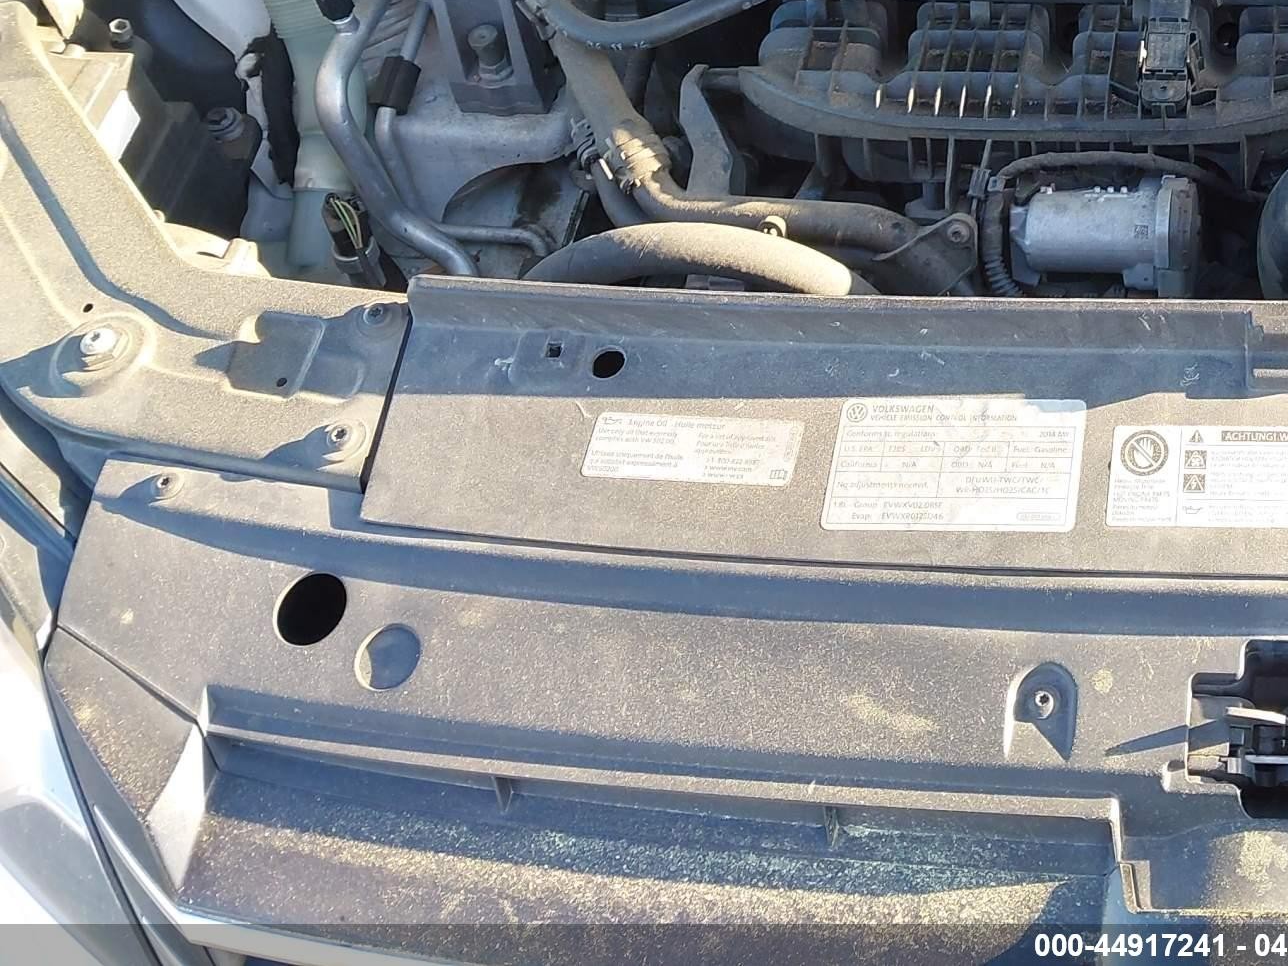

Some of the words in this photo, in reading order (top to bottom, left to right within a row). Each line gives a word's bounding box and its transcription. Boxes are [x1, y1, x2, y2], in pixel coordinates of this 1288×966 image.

[872, 404, 935, 413] VOLKSWAGEN
[900, 414, 932, 422] EMISSION
[970, 414, 1017, 422] INFORMATION
